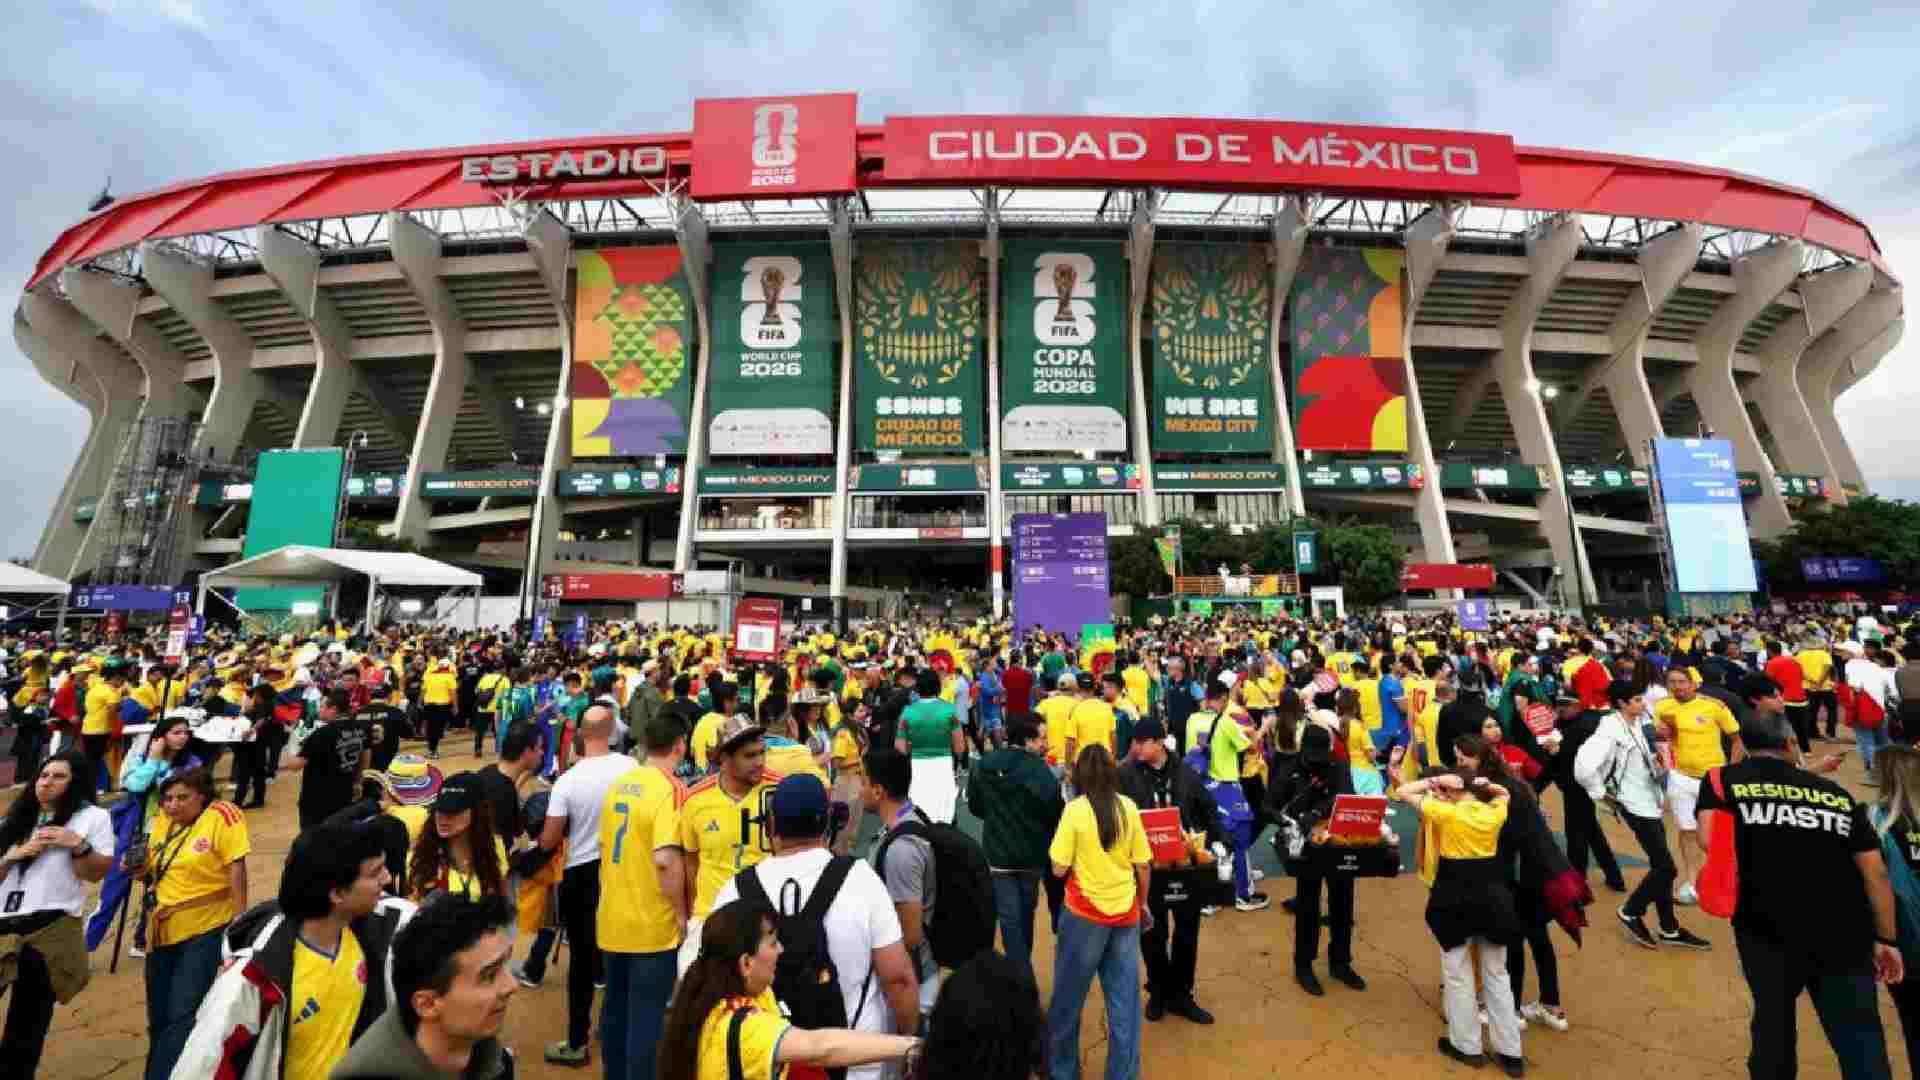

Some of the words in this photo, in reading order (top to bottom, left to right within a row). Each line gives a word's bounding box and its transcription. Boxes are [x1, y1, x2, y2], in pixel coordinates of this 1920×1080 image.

[928, 130, 1148, 161] CIUDAD
[1176, 135, 1252, 164] DE
[1272, 131, 1479, 176] MÉXICO
[462, 146, 665, 182] ESTADIO
[751, 175, 797, 186] 2026
[758, 329, 785, 340] FIFA
[1051, 326, 1080, 337] FIFA
[741, 351, 778, 362] WORLD
[780, 351, 802, 362] CUP
[1033, 348, 1096, 366] COPA
[740, 362, 802, 377] 2026
[1033, 366, 1096, 378] MUNDIAL
[1033, 380, 1097, 394] 2026
[1165, 396, 1204, 416] WE
[1207, 396, 1259, 417] ARE
[875, 418, 939, 432] CIUDAD
[941, 418, 962, 432] DE
[1165, 418, 1222, 432] MEXICO
[1225, 418, 1258, 432] CITY
[550, 584, 563, 597] 15
[1731, 782, 1852, 812] RESIDUOS
[1738, 801, 1853, 838] WASTE
[612, 802, 629, 864] 7
